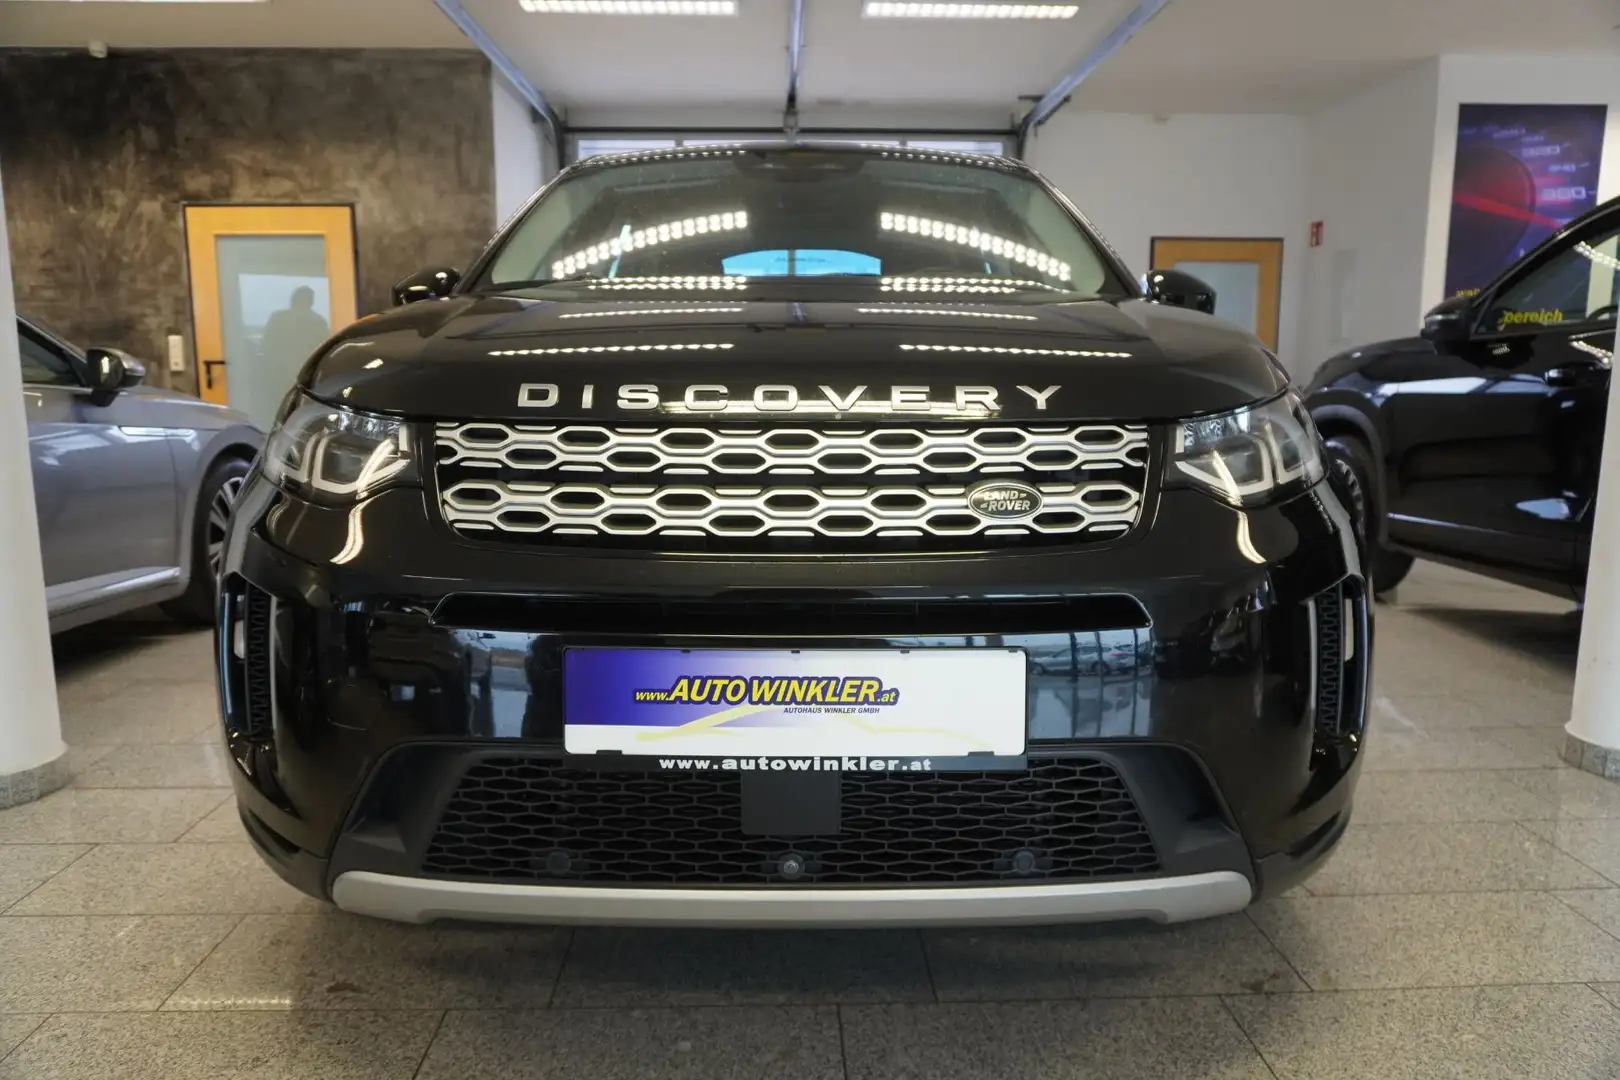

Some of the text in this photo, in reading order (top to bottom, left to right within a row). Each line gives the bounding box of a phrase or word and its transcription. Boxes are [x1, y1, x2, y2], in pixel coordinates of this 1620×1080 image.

[518, 383, 1062, 412] DISCOVERY
[983, 490, 1019, 501] LAND
[988, 500, 1031, 512] ROVER
[659, 755, 932, 771] www.autowinkler.at
